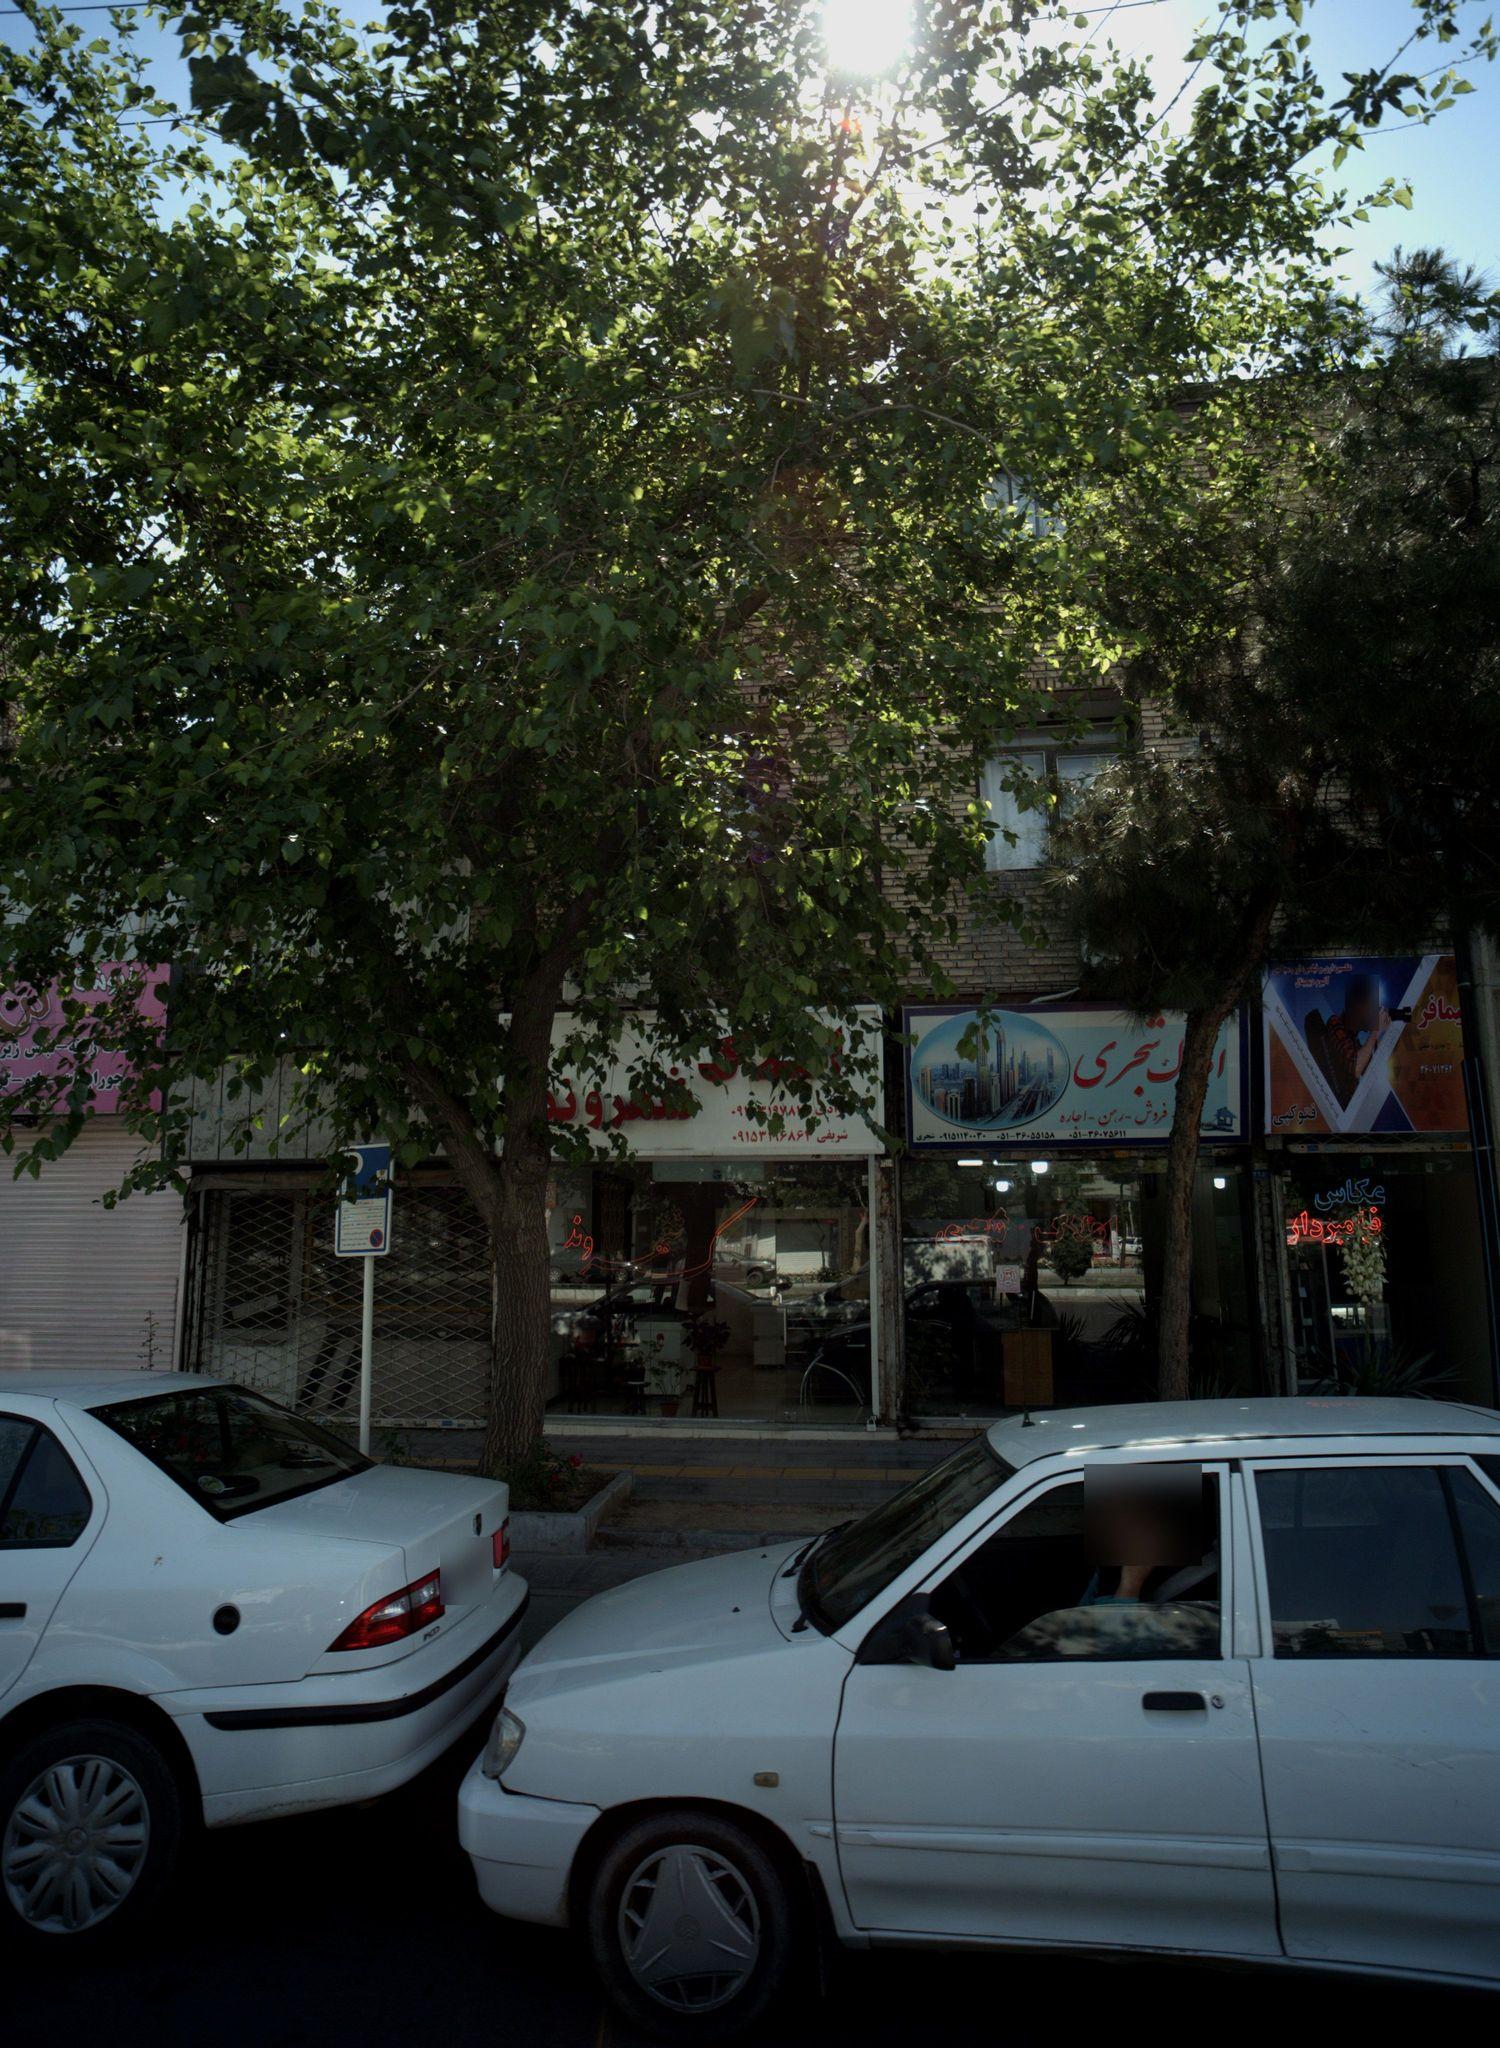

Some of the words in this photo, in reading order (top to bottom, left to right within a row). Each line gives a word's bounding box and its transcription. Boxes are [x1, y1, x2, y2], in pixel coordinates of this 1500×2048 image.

[88, 1070, 124, 1090] جورا
[1134, 1100, 1168, 1125] فروش
[732, 1129, 812, 1144] ۰۹۱۵۳۱۶۸۶
[816, 1129, 849, 1144] شریفی
